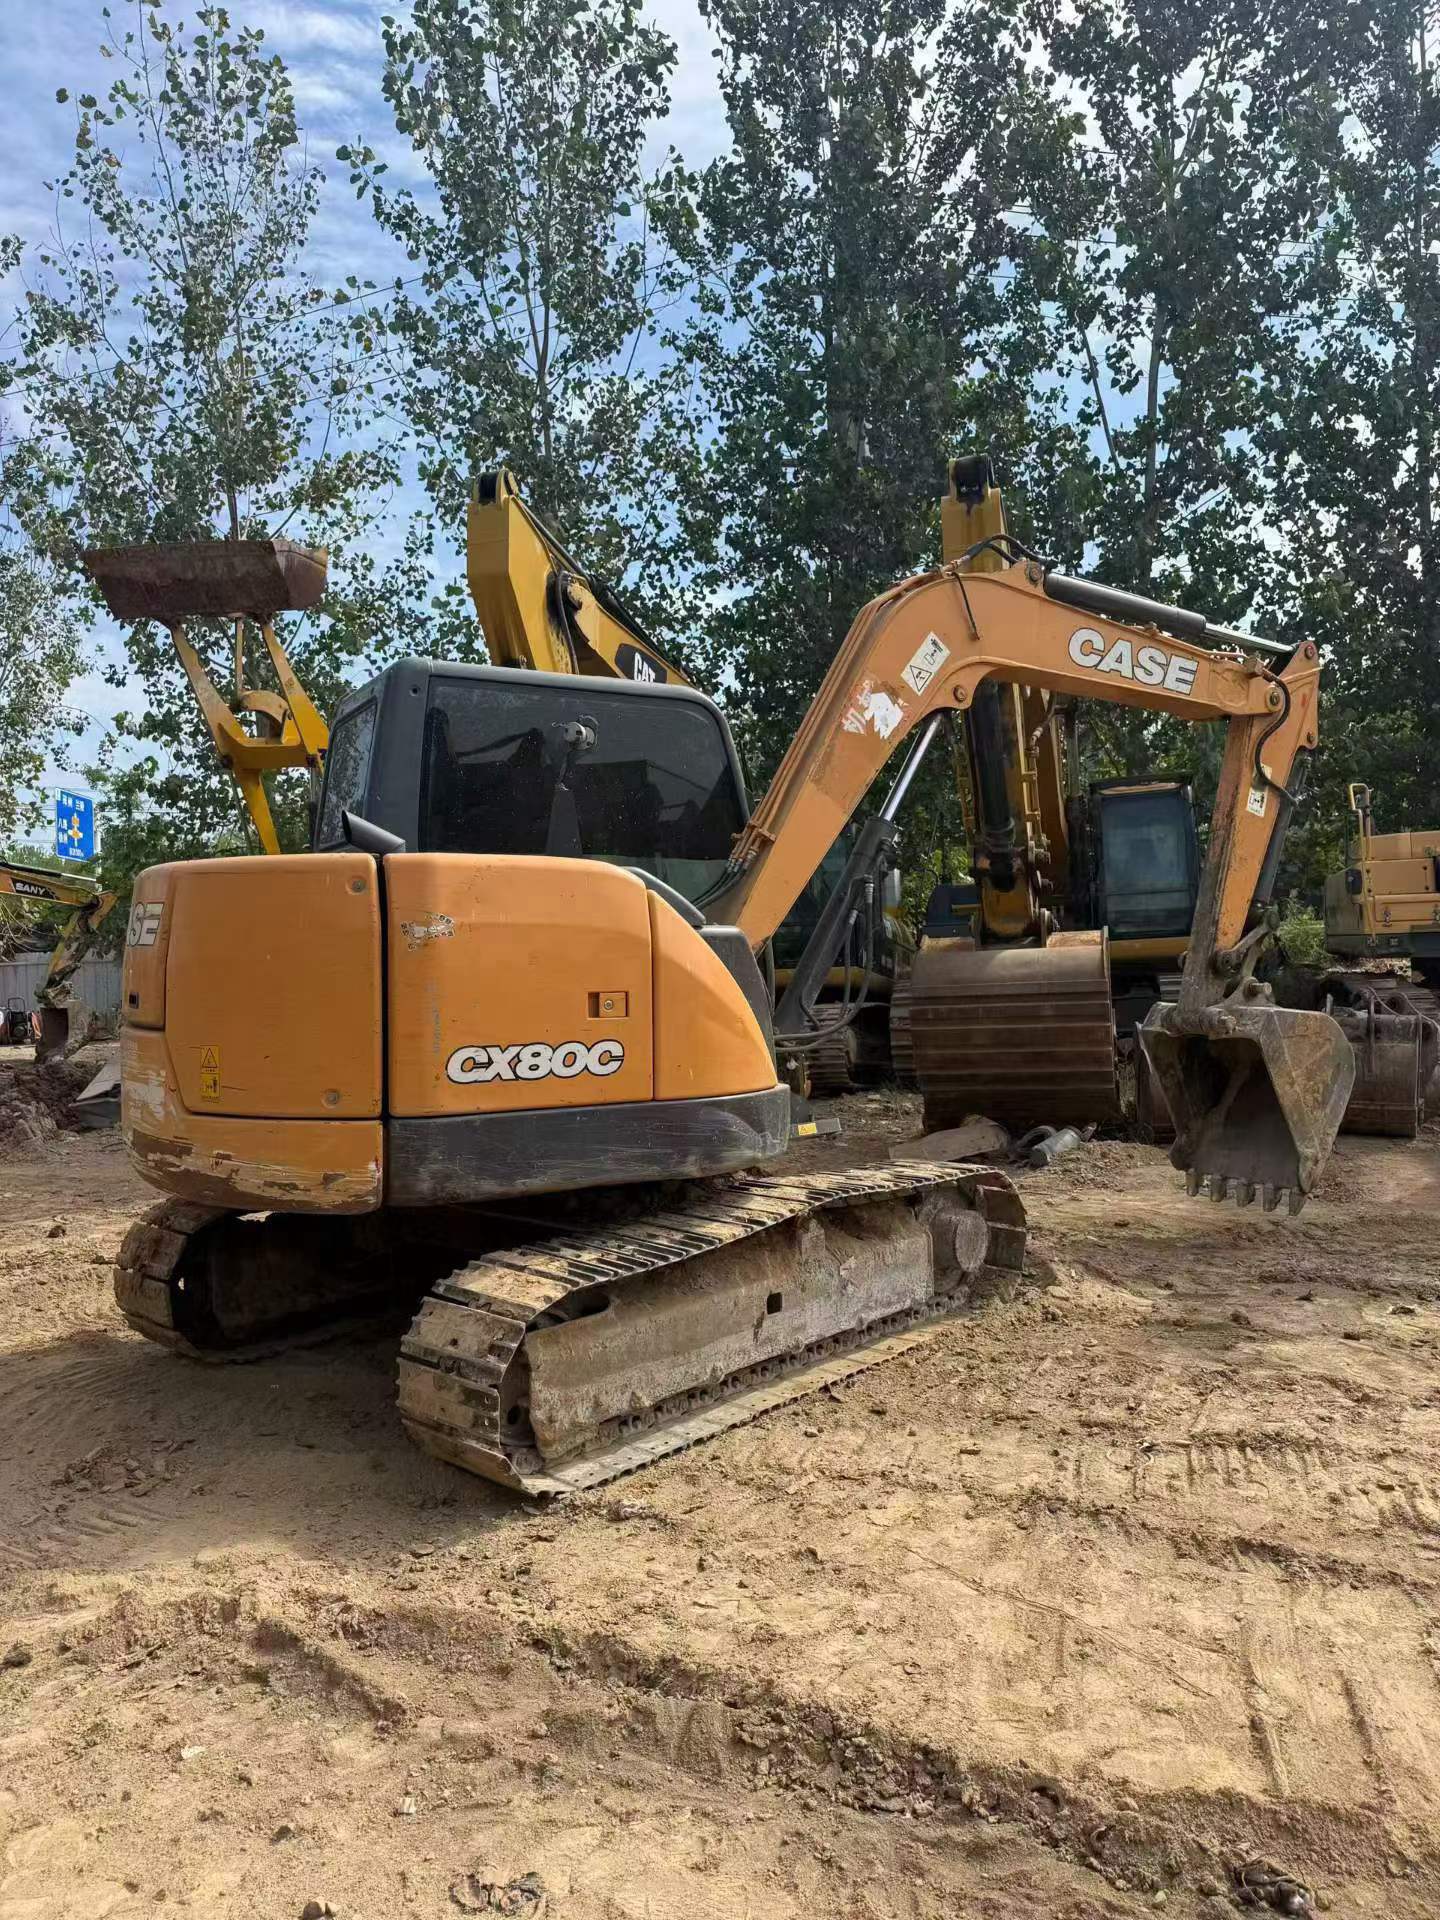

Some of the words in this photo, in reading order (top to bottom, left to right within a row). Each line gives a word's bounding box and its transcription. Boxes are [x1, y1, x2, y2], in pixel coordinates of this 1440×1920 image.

[634, 652, 656, 682] CAT
[1068, 627, 1199, 695] CASE
[15, 882, 46, 895] SANY
[127, 901, 165, 947] SE
[446, 1039, 625, 1084] CX80C
